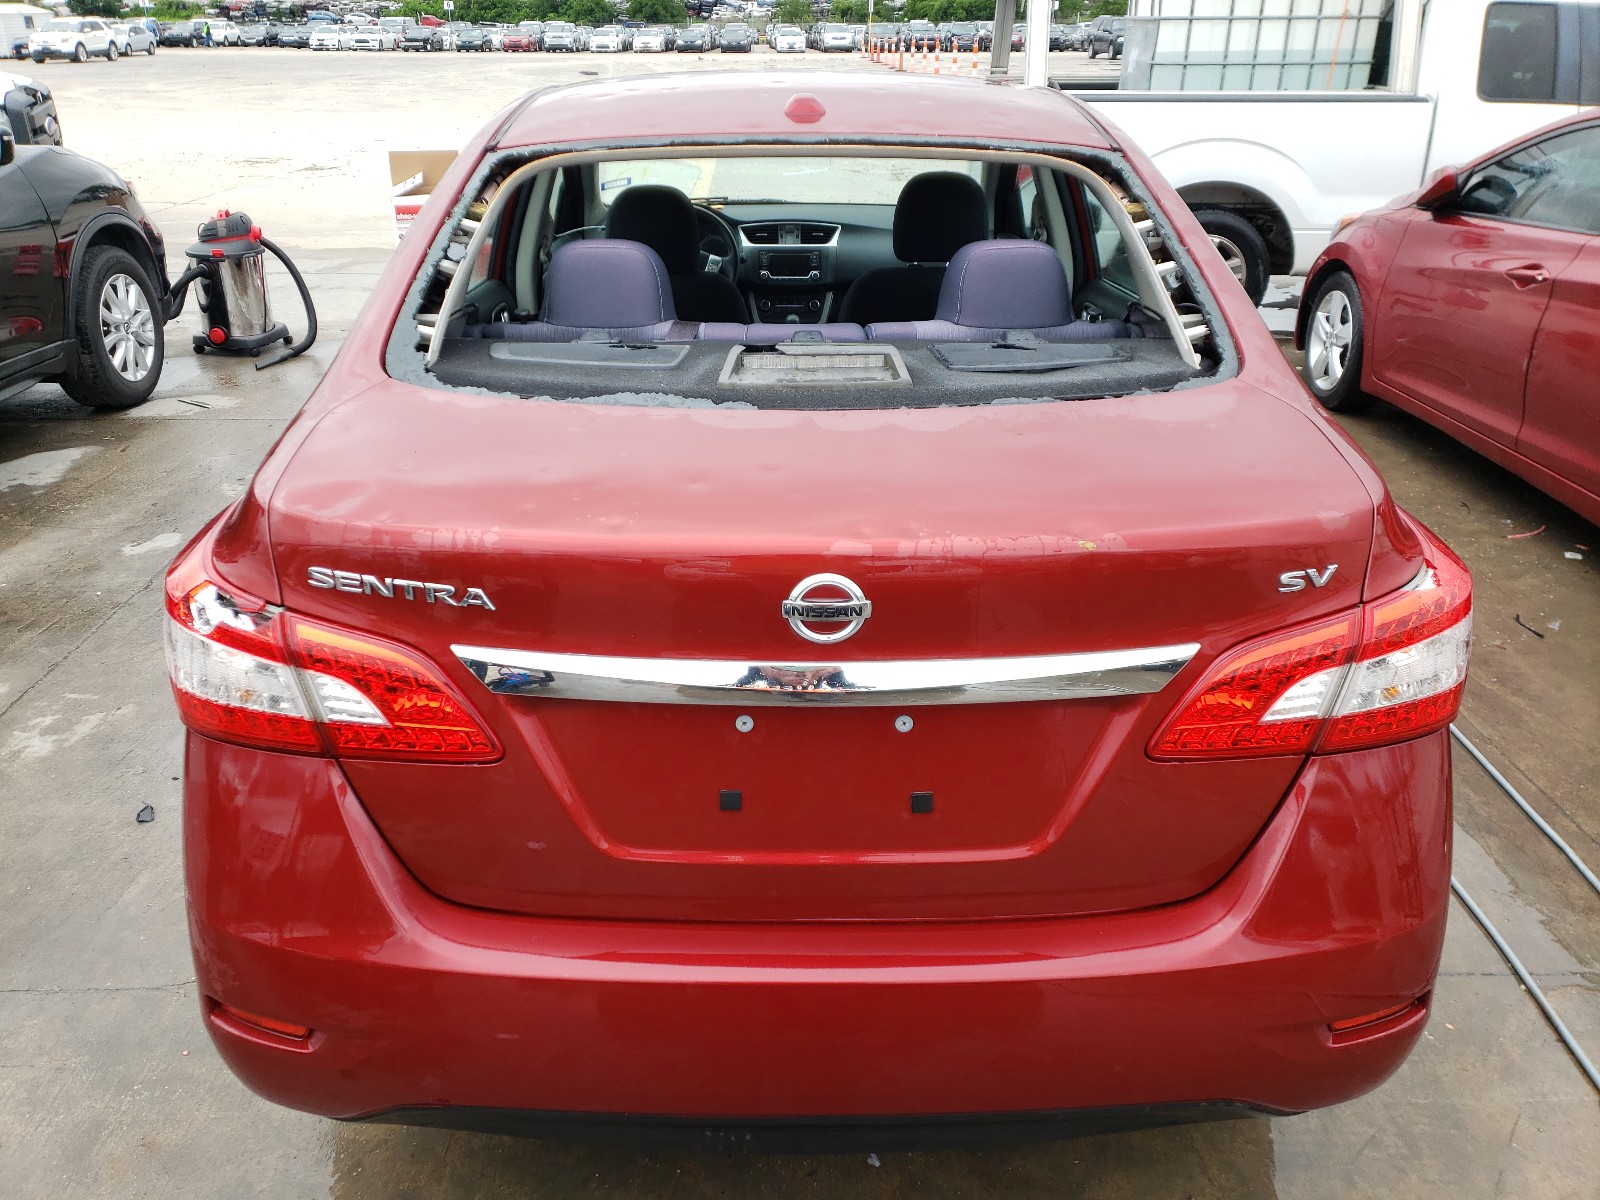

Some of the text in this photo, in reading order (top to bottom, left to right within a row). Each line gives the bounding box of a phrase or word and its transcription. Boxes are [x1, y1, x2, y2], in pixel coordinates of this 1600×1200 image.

[307, 566, 496, 611] SENTRA
[1278, 563, 1339, 593] SV
[791, 605, 863, 618] NISSAN
